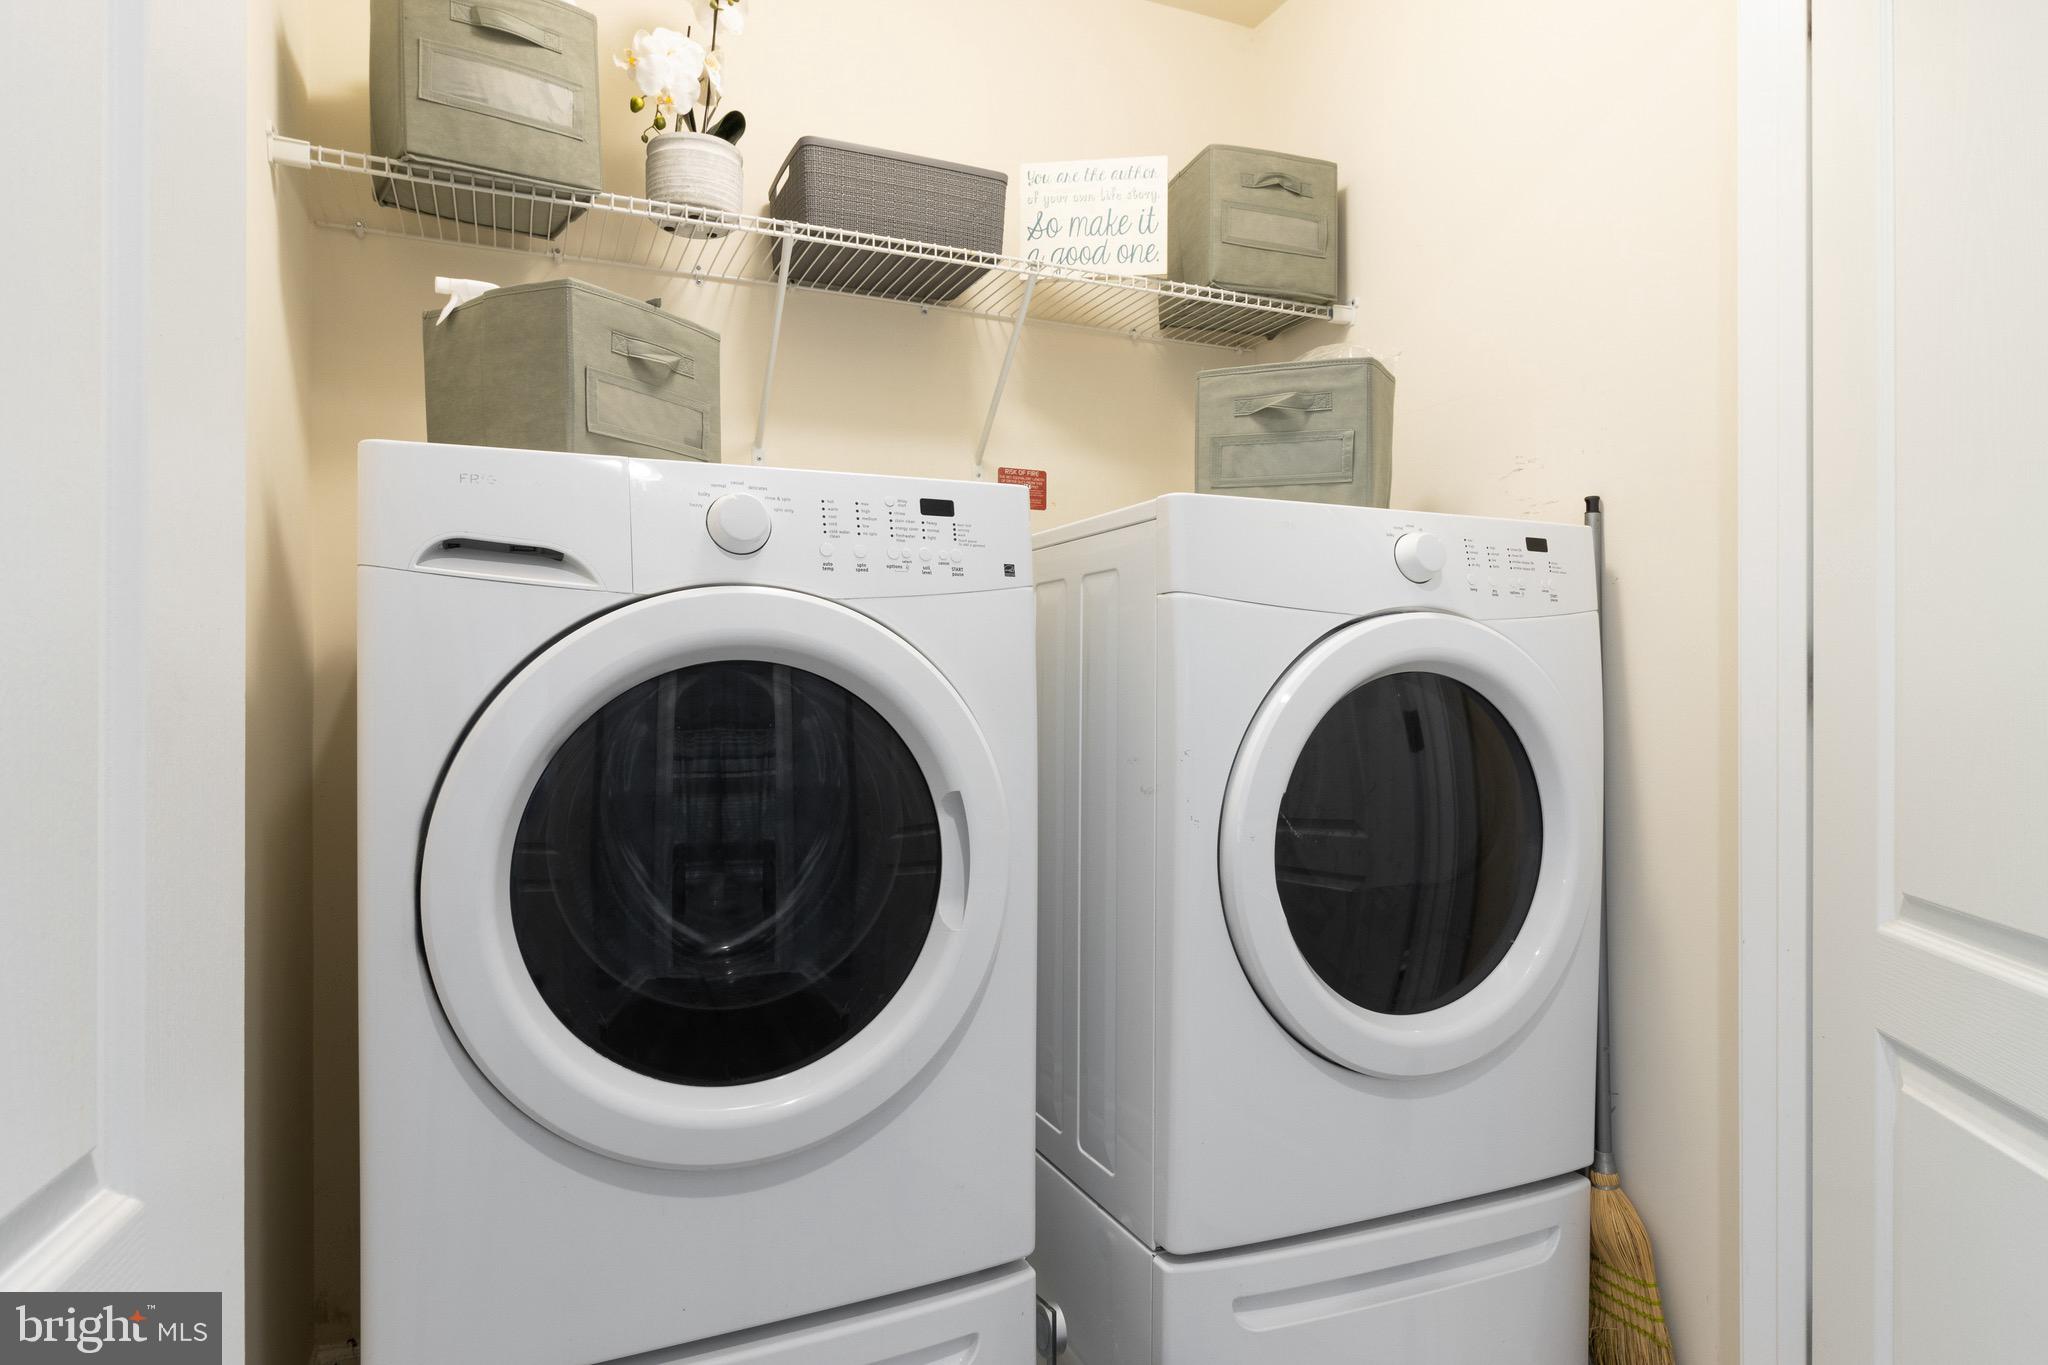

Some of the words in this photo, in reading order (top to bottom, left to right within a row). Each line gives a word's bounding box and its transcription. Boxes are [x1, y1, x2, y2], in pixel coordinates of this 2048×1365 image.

[1027, 170, 1050, 187] You
[1056, 171, 1079, 184] are
[1084, 167, 1107, 182] the
[1111, 165, 1159, 182] author
[1027, 190, 1039, 205] of
[1042, 193, 1069, 208] your
[1073, 194, 1096, 203] own
[1027, 210, 1063, 241] So
[1069, 207, 1132, 238] make
[1138, 205, 1159, 235] it
[1117, 242, 1160, 264] one.
